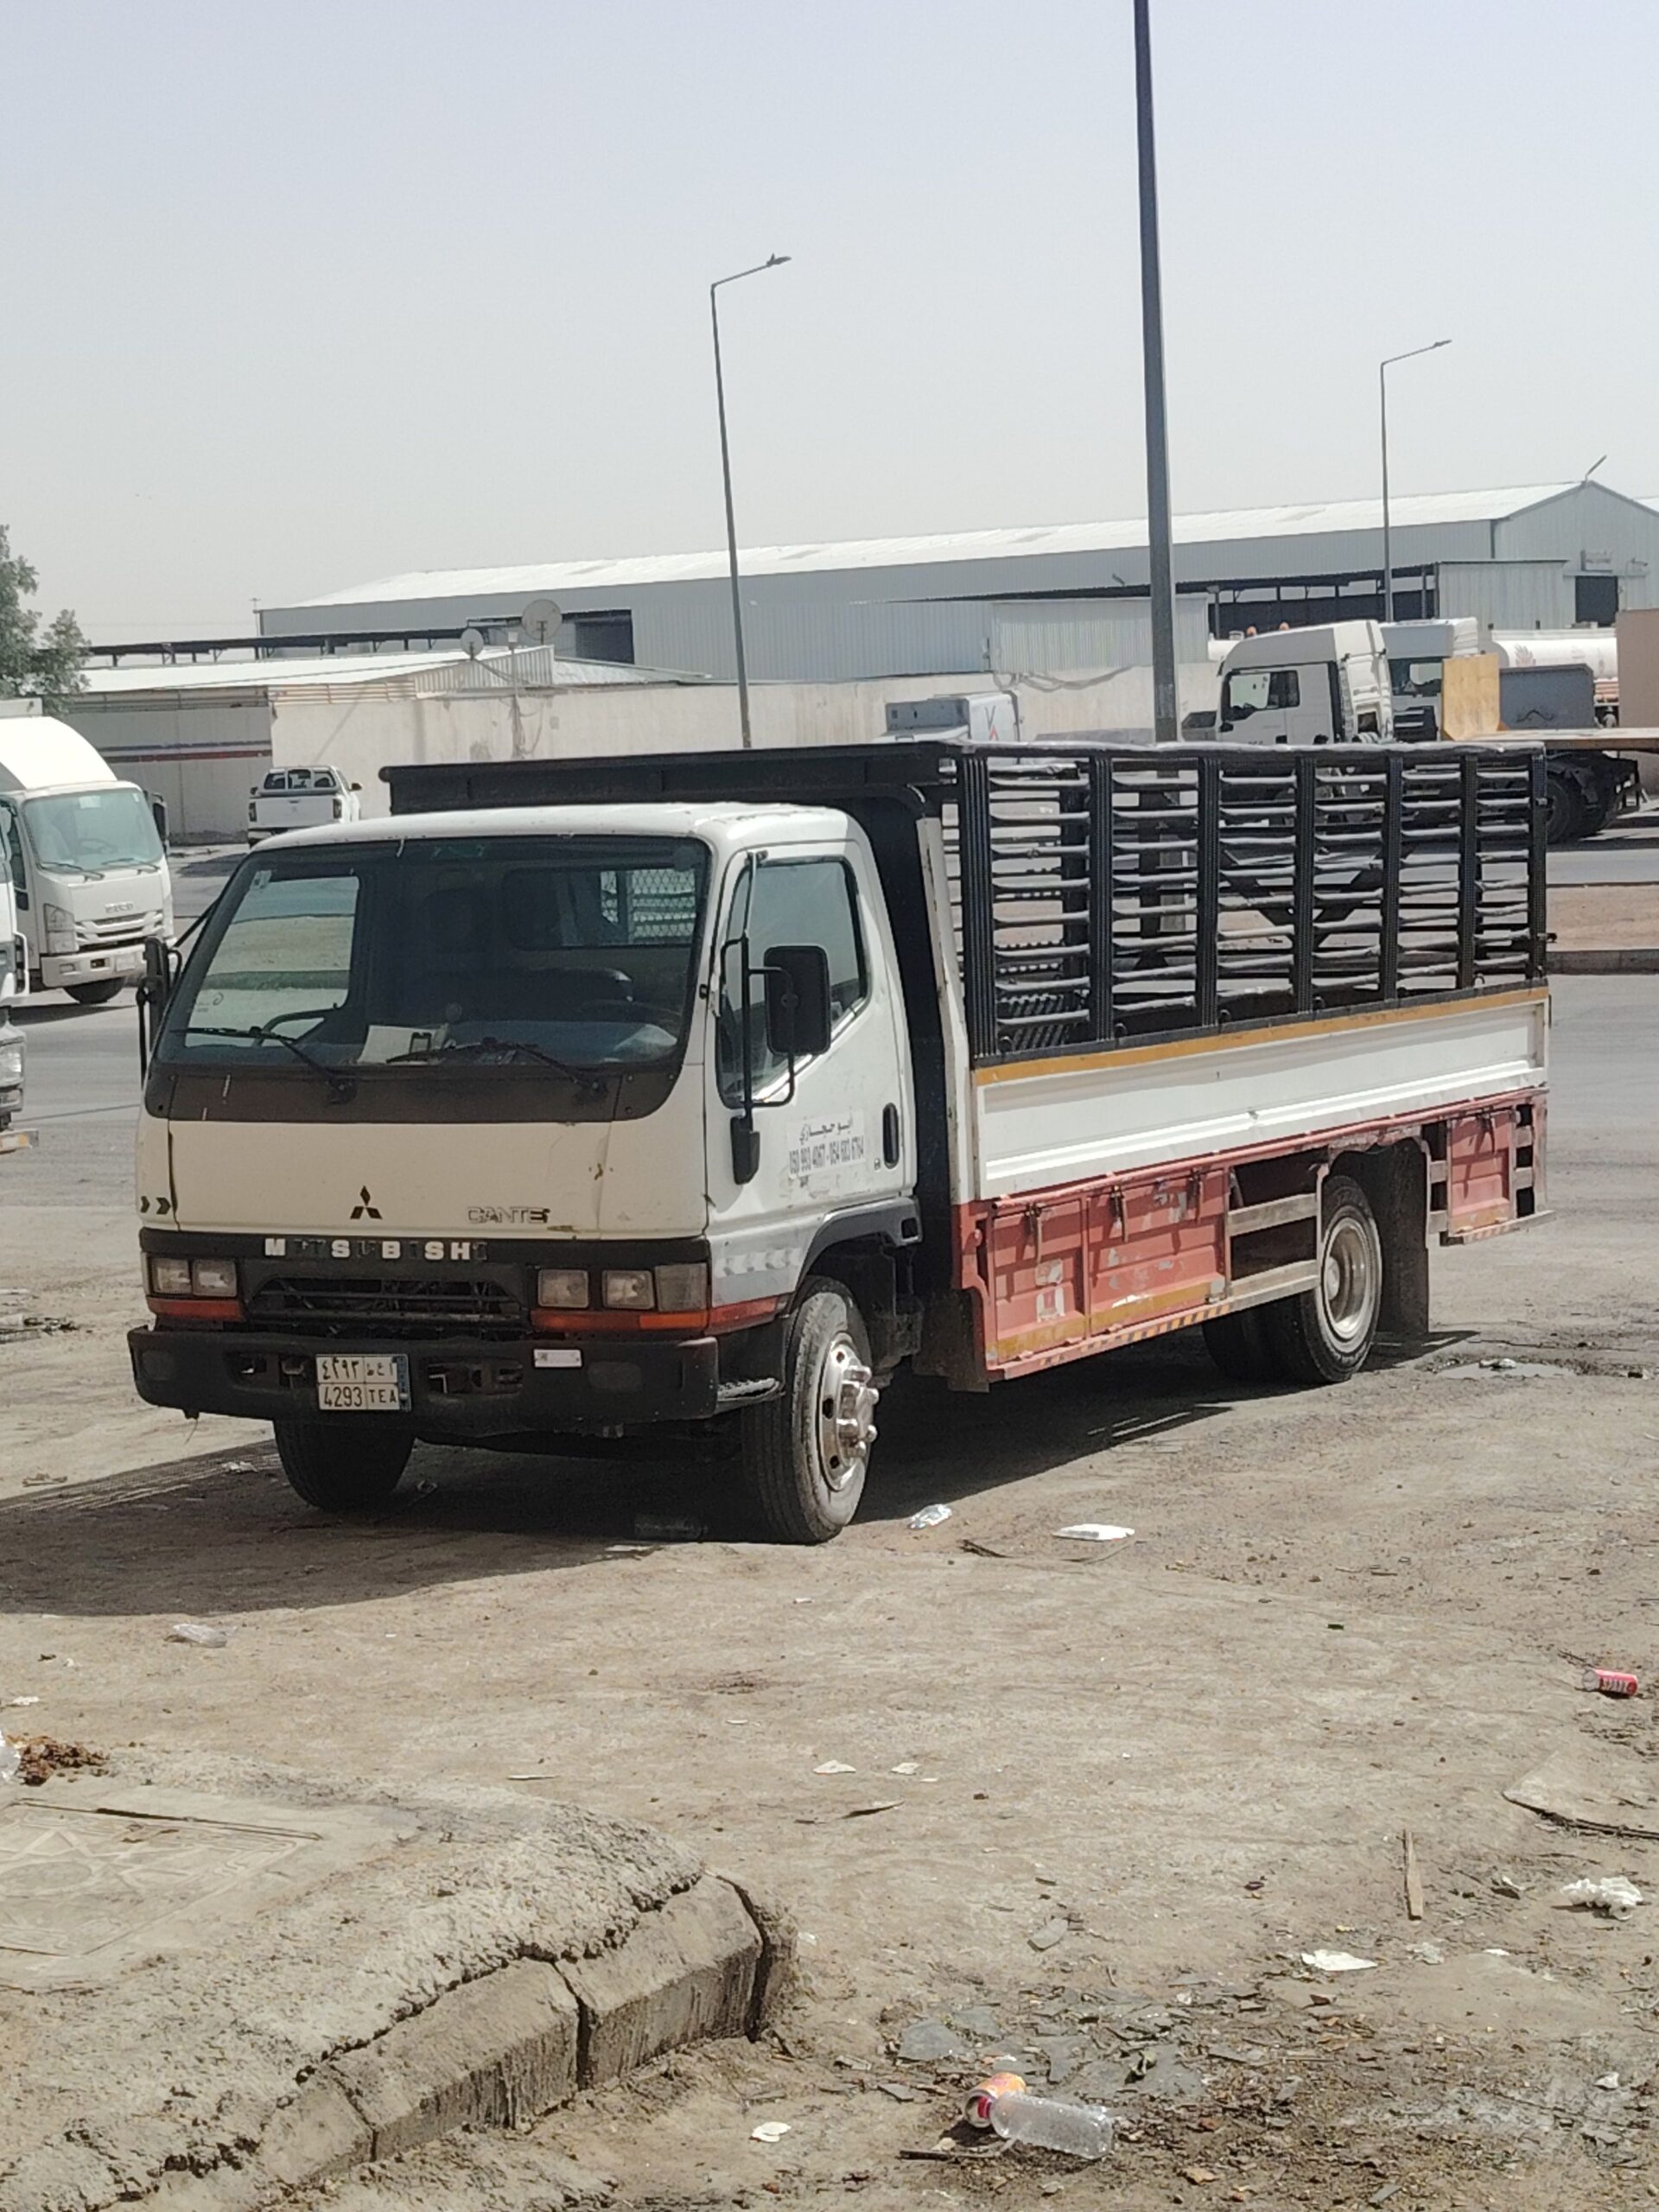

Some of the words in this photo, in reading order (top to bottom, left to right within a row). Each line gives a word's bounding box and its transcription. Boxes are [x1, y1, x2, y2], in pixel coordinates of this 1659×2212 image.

[467, 1206, 550, 1224] CANTE
[264, 1238, 488, 1261] MSBSH
[324, 1386, 363, 1408] 4293
[368, 1389, 397, 1403] TEA
